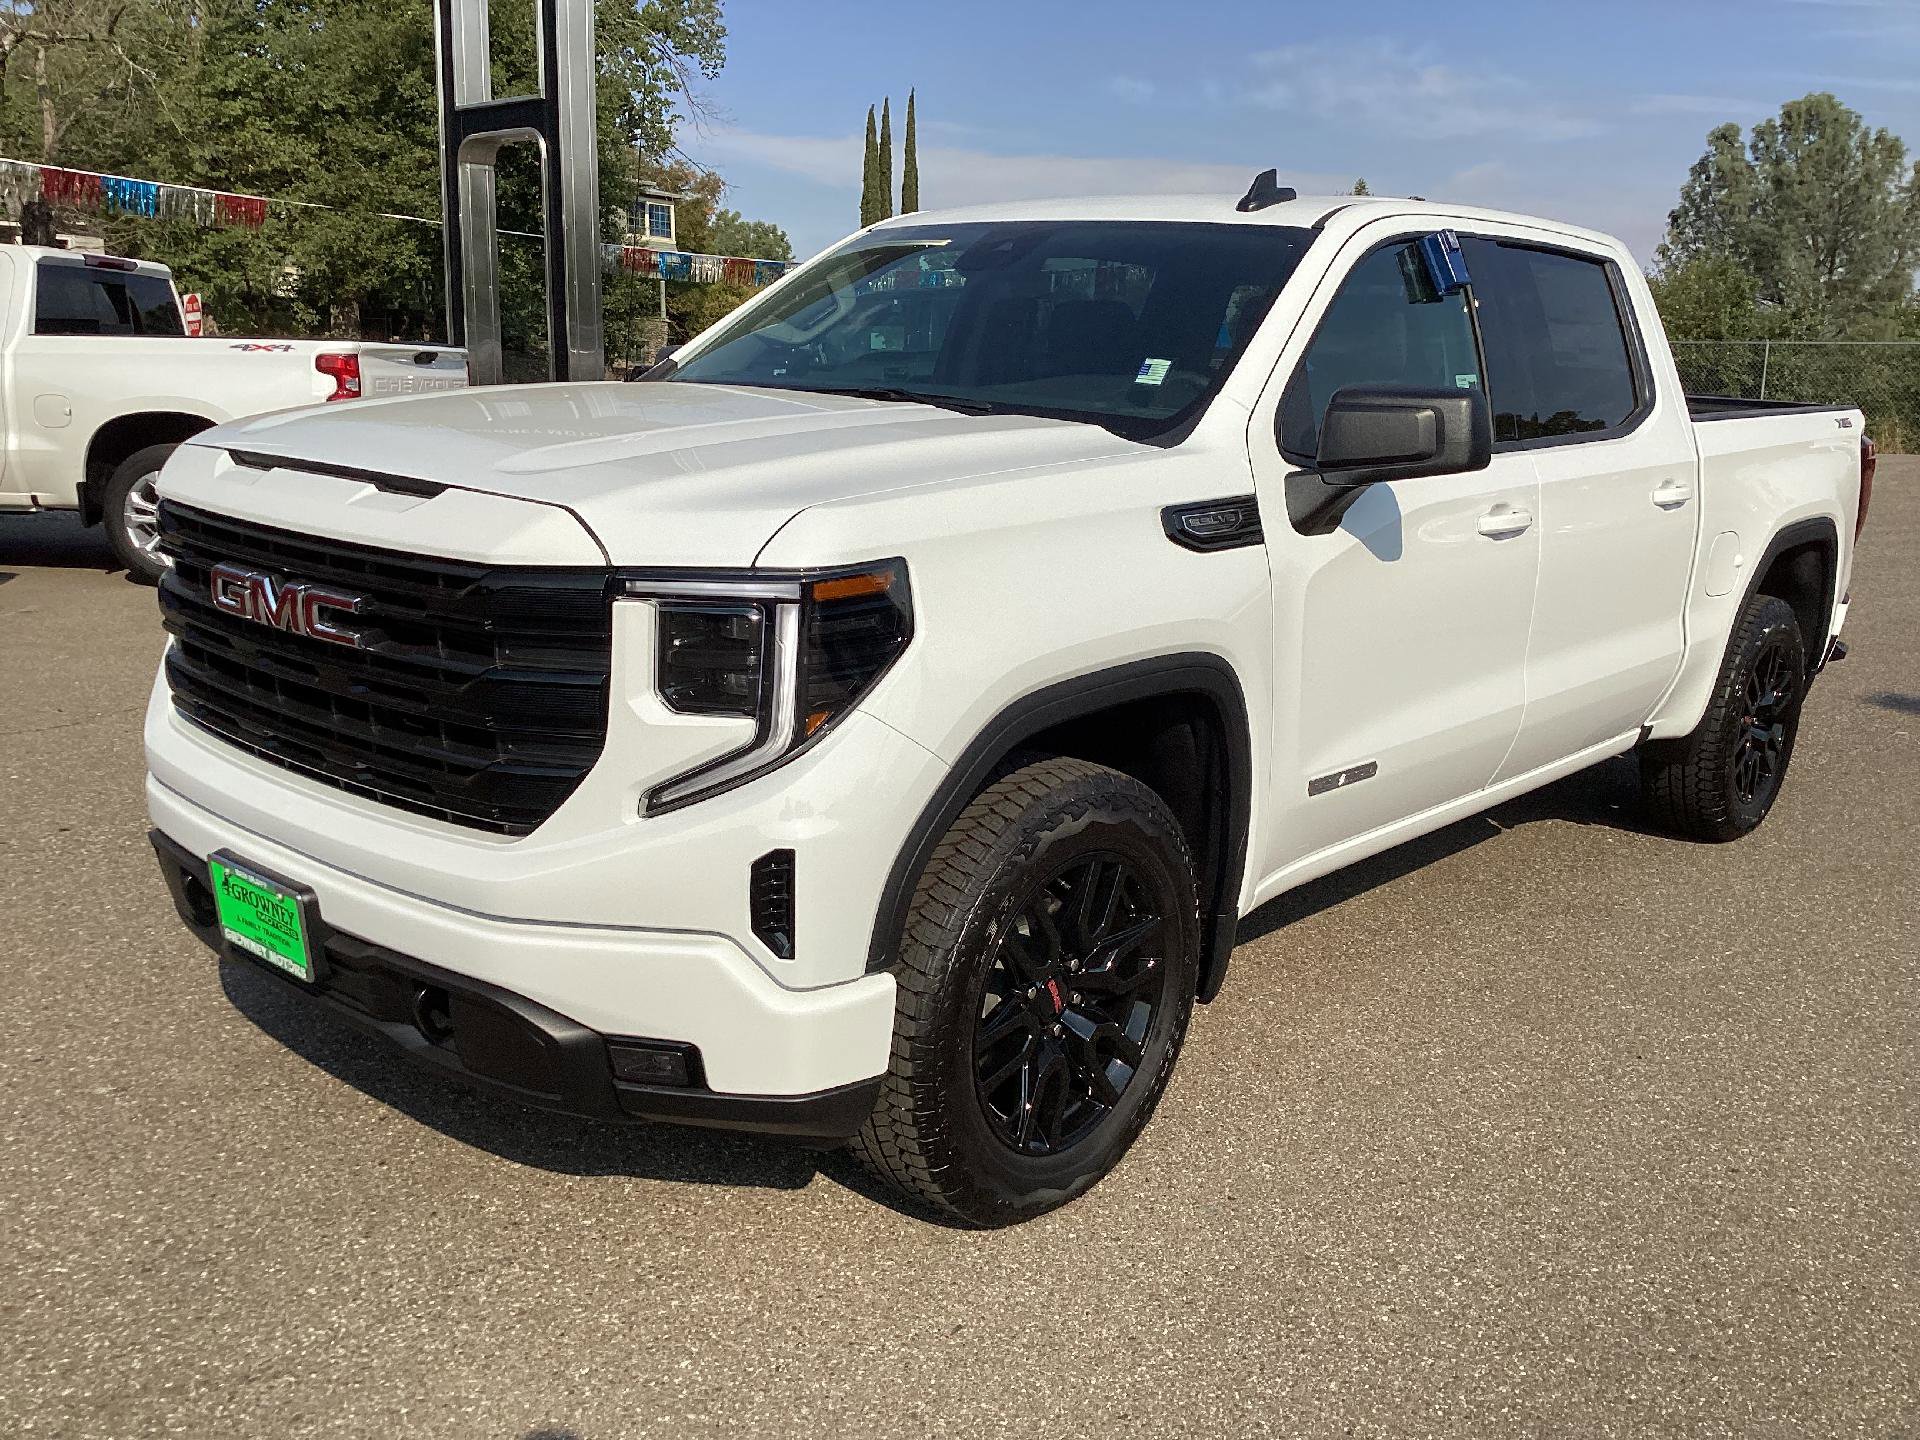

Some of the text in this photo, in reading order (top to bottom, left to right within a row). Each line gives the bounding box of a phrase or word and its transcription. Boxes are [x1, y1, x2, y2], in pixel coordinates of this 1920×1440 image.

[211, 563, 364, 649] GMC
[231, 883, 295, 928] GROWNEY
[256, 910, 299, 941] MOTORS
